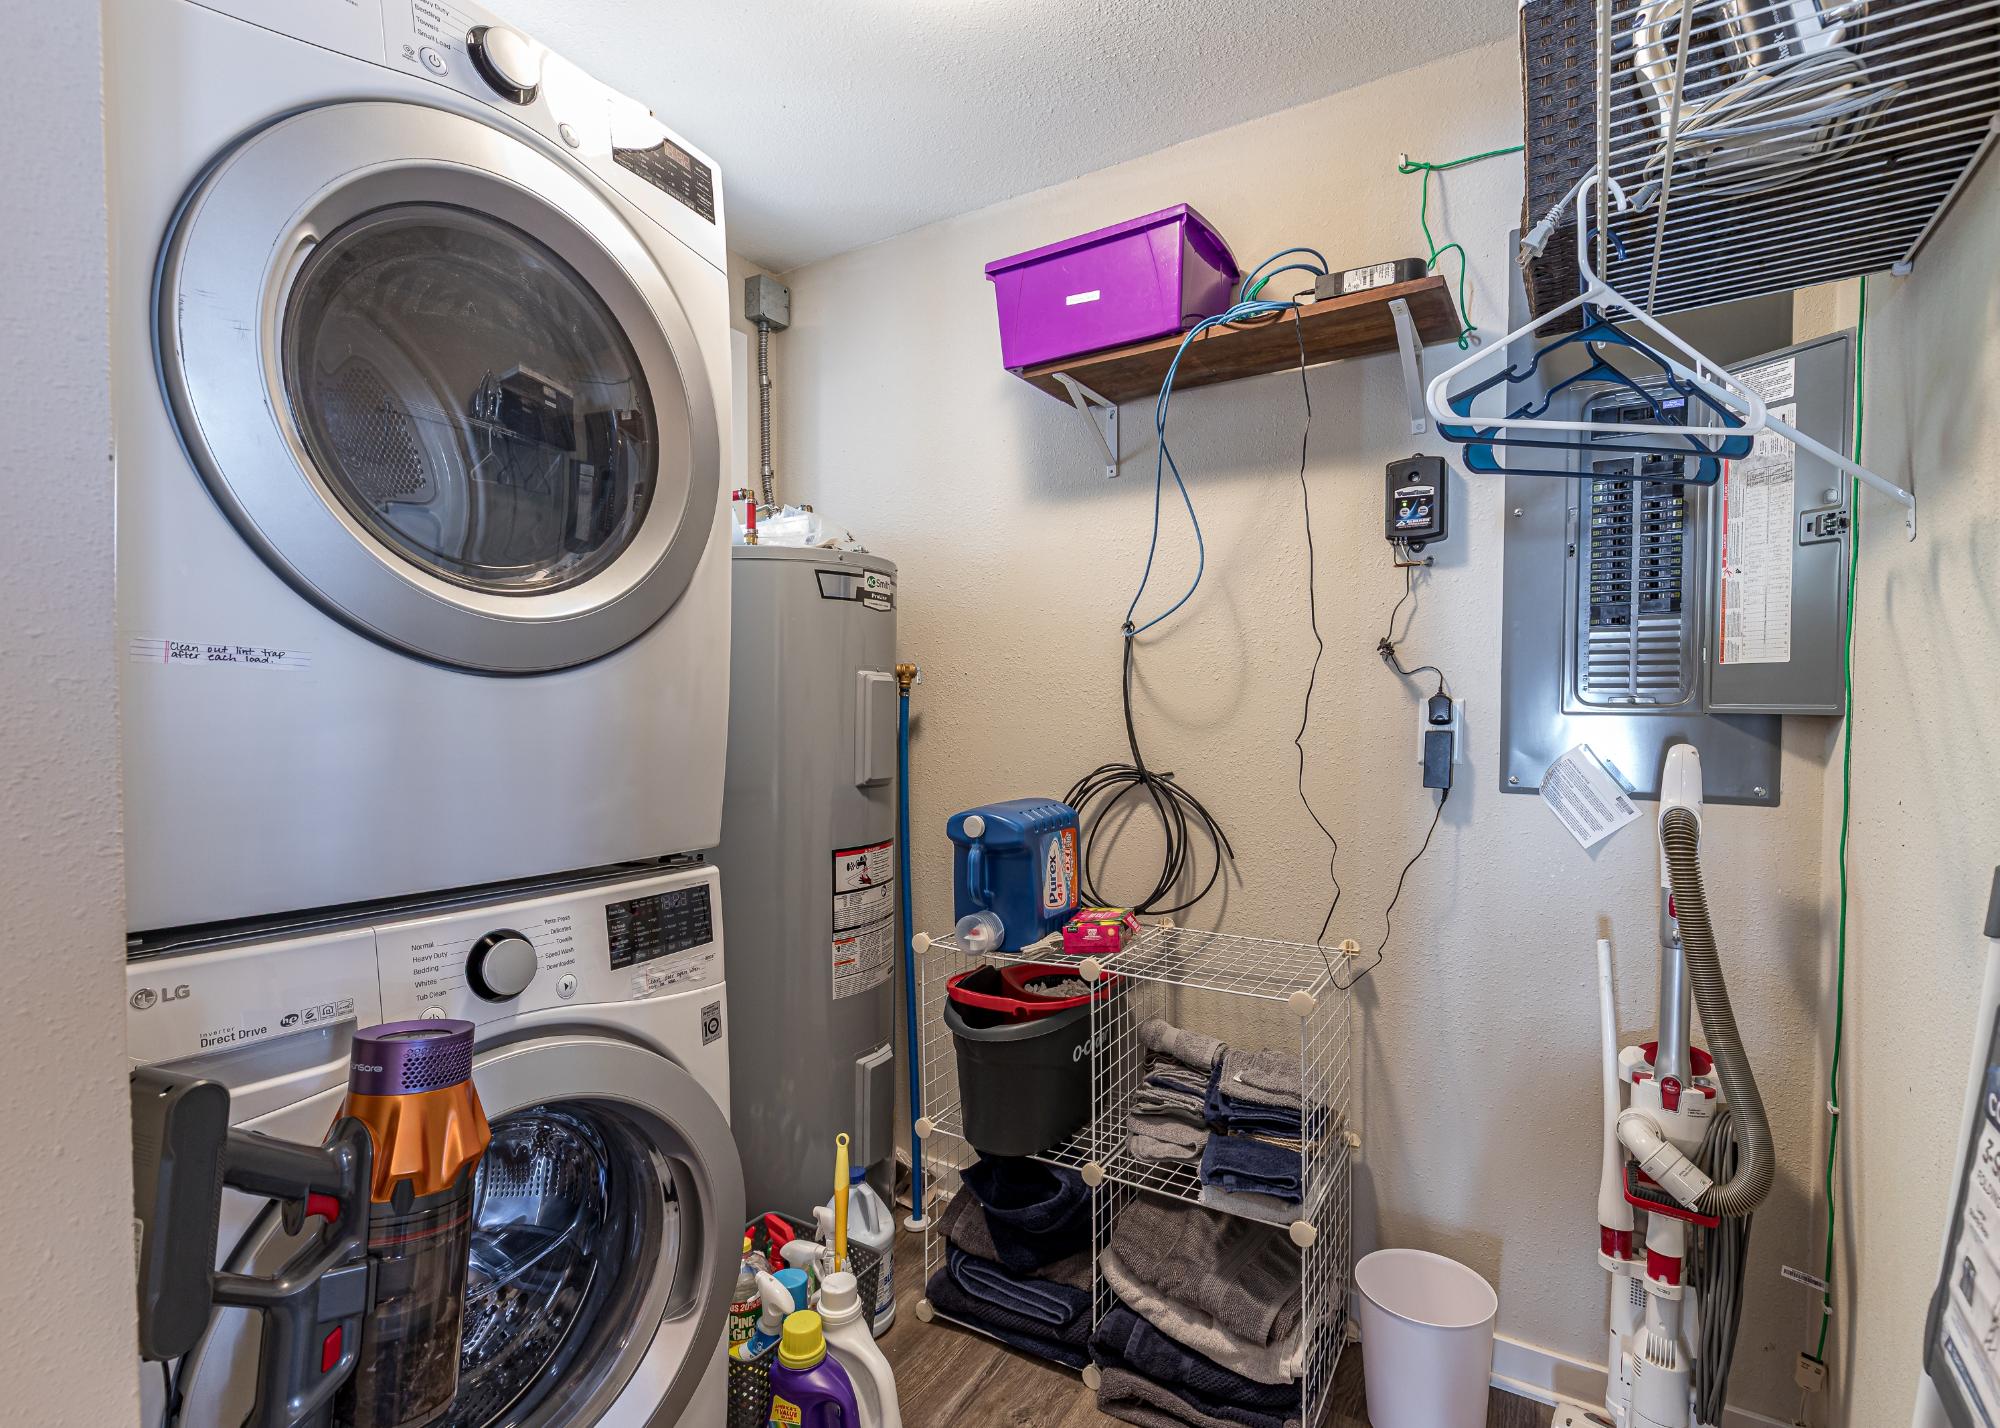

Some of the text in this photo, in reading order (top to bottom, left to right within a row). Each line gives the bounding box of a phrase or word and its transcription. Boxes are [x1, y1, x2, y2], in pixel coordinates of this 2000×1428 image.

[417, 28, 451, 50] Small Load
[169, 641, 286, 659] Clean out lint trap
[171, 651, 274, 664] after each load.
[1050, 855, 1058, 904] Purex
[411, 941, 434, 951] Normal
[413, 951, 448, 963] Heavy Duty
[413, 965, 439, 975] Bedding
[414, 979, 437, 988] Whites
[161, 984, 191, 1003] LG
[429, 990, 447, 999] Clean
[200, 1026, 236, 1039] Inverter
[200, 1026, 268, 1048] Direct Drive
